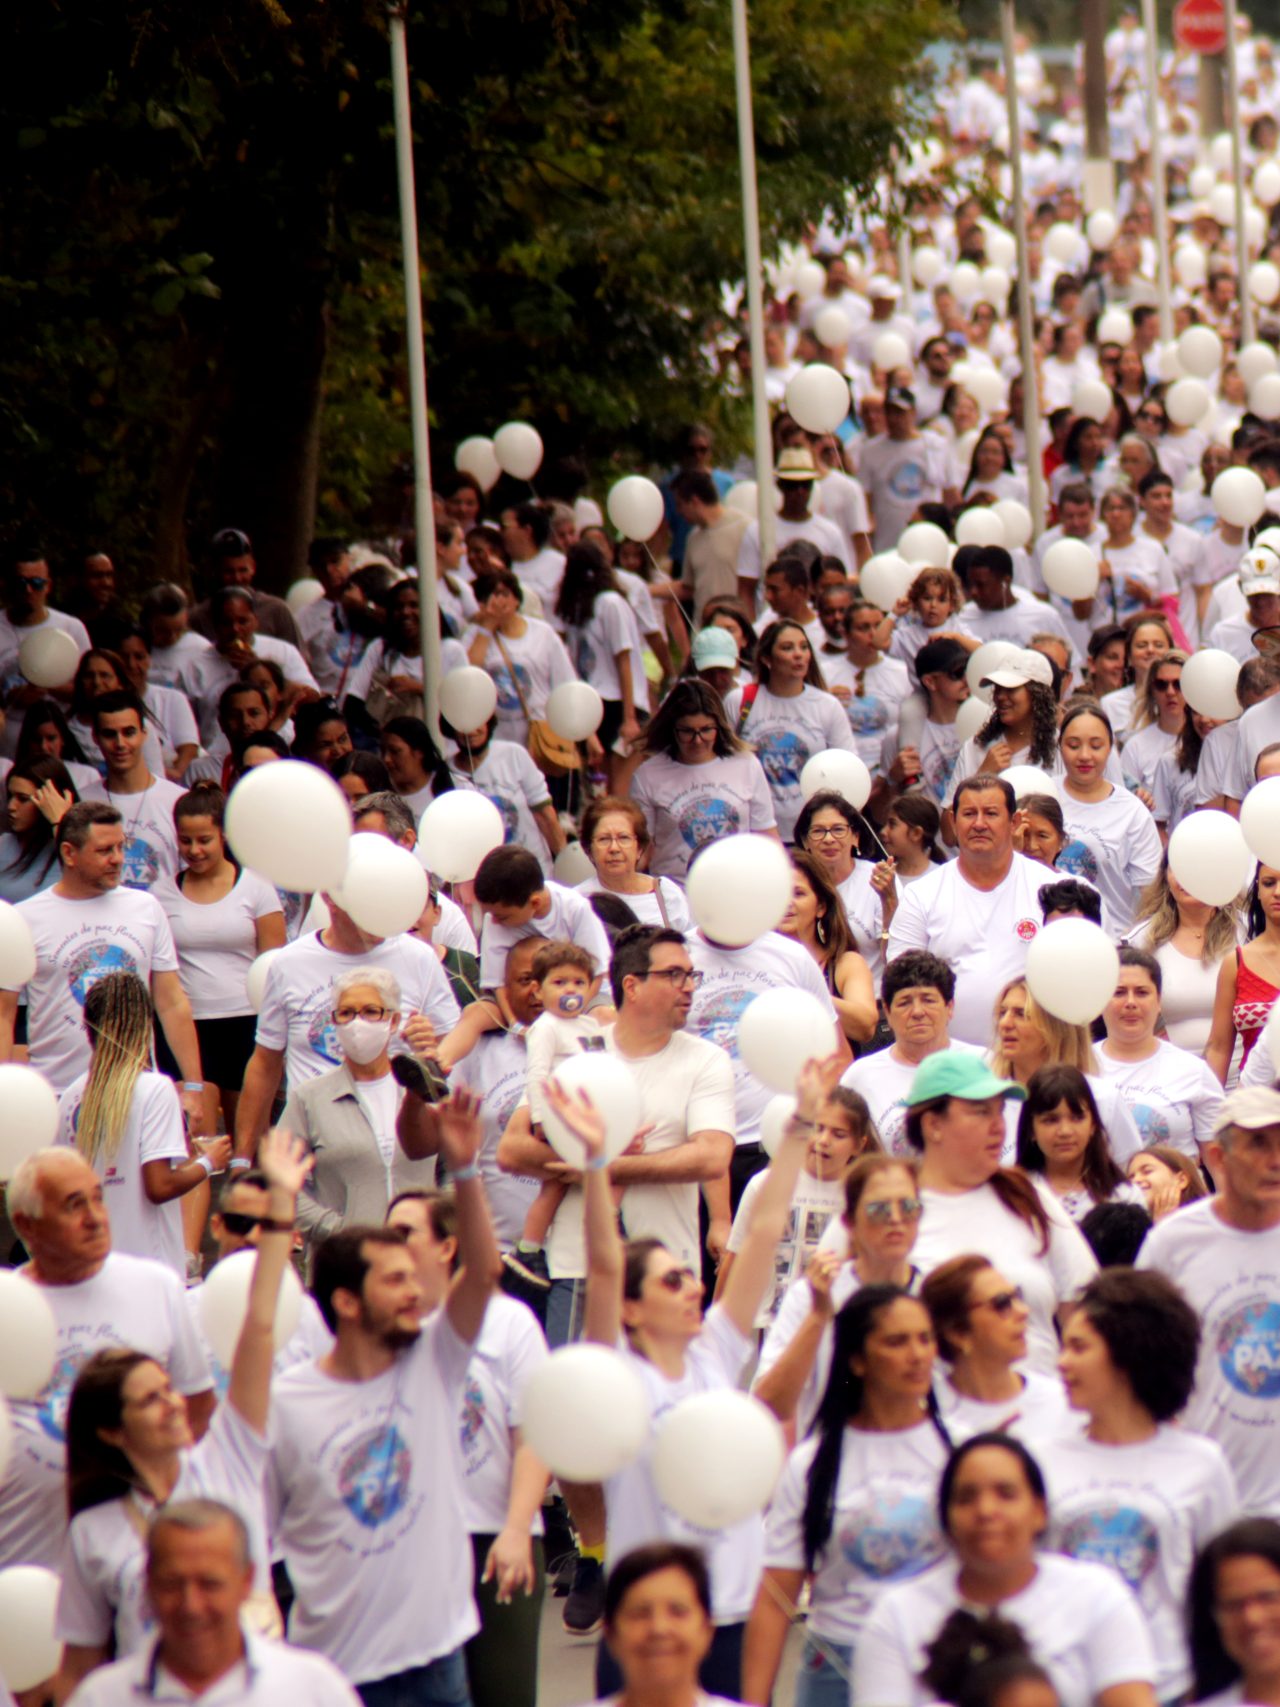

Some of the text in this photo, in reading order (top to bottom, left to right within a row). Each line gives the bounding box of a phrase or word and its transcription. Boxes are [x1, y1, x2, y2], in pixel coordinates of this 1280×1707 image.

[120, 864, 150, 883] AZ
[81, 922, 92, 934] de
[95, 925, 113, 936] paz
[718, 967, 730, 980] de
[732, 970, 753, 982] paz
